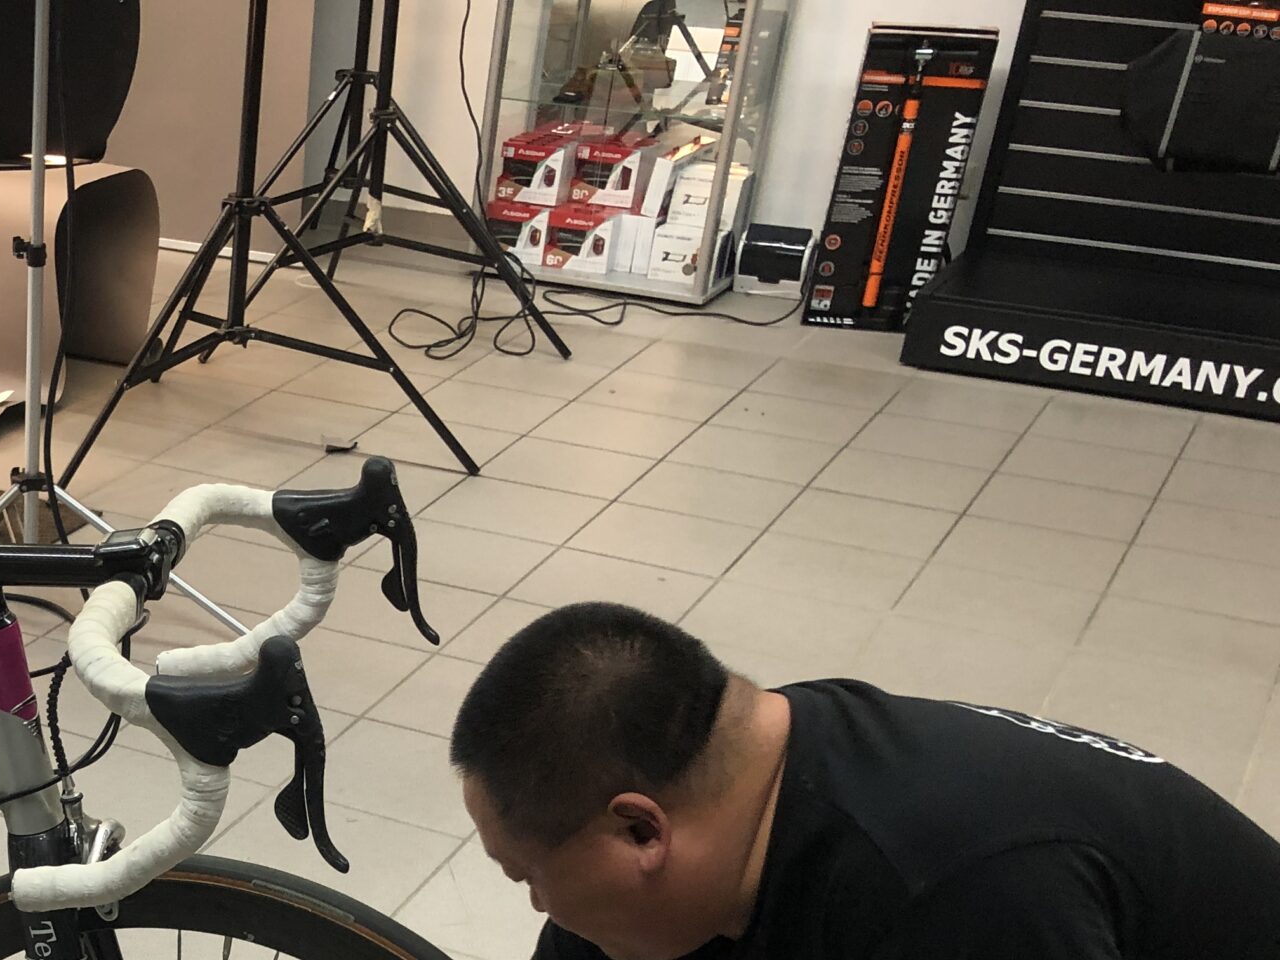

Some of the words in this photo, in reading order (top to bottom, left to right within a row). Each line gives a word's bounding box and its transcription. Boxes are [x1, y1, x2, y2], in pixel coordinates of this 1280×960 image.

[928, 111, 977, 225] GERMANY
[920, 229, 948, 253] IN
[939, 325, 1280, 404] SKS-GERMANY.
